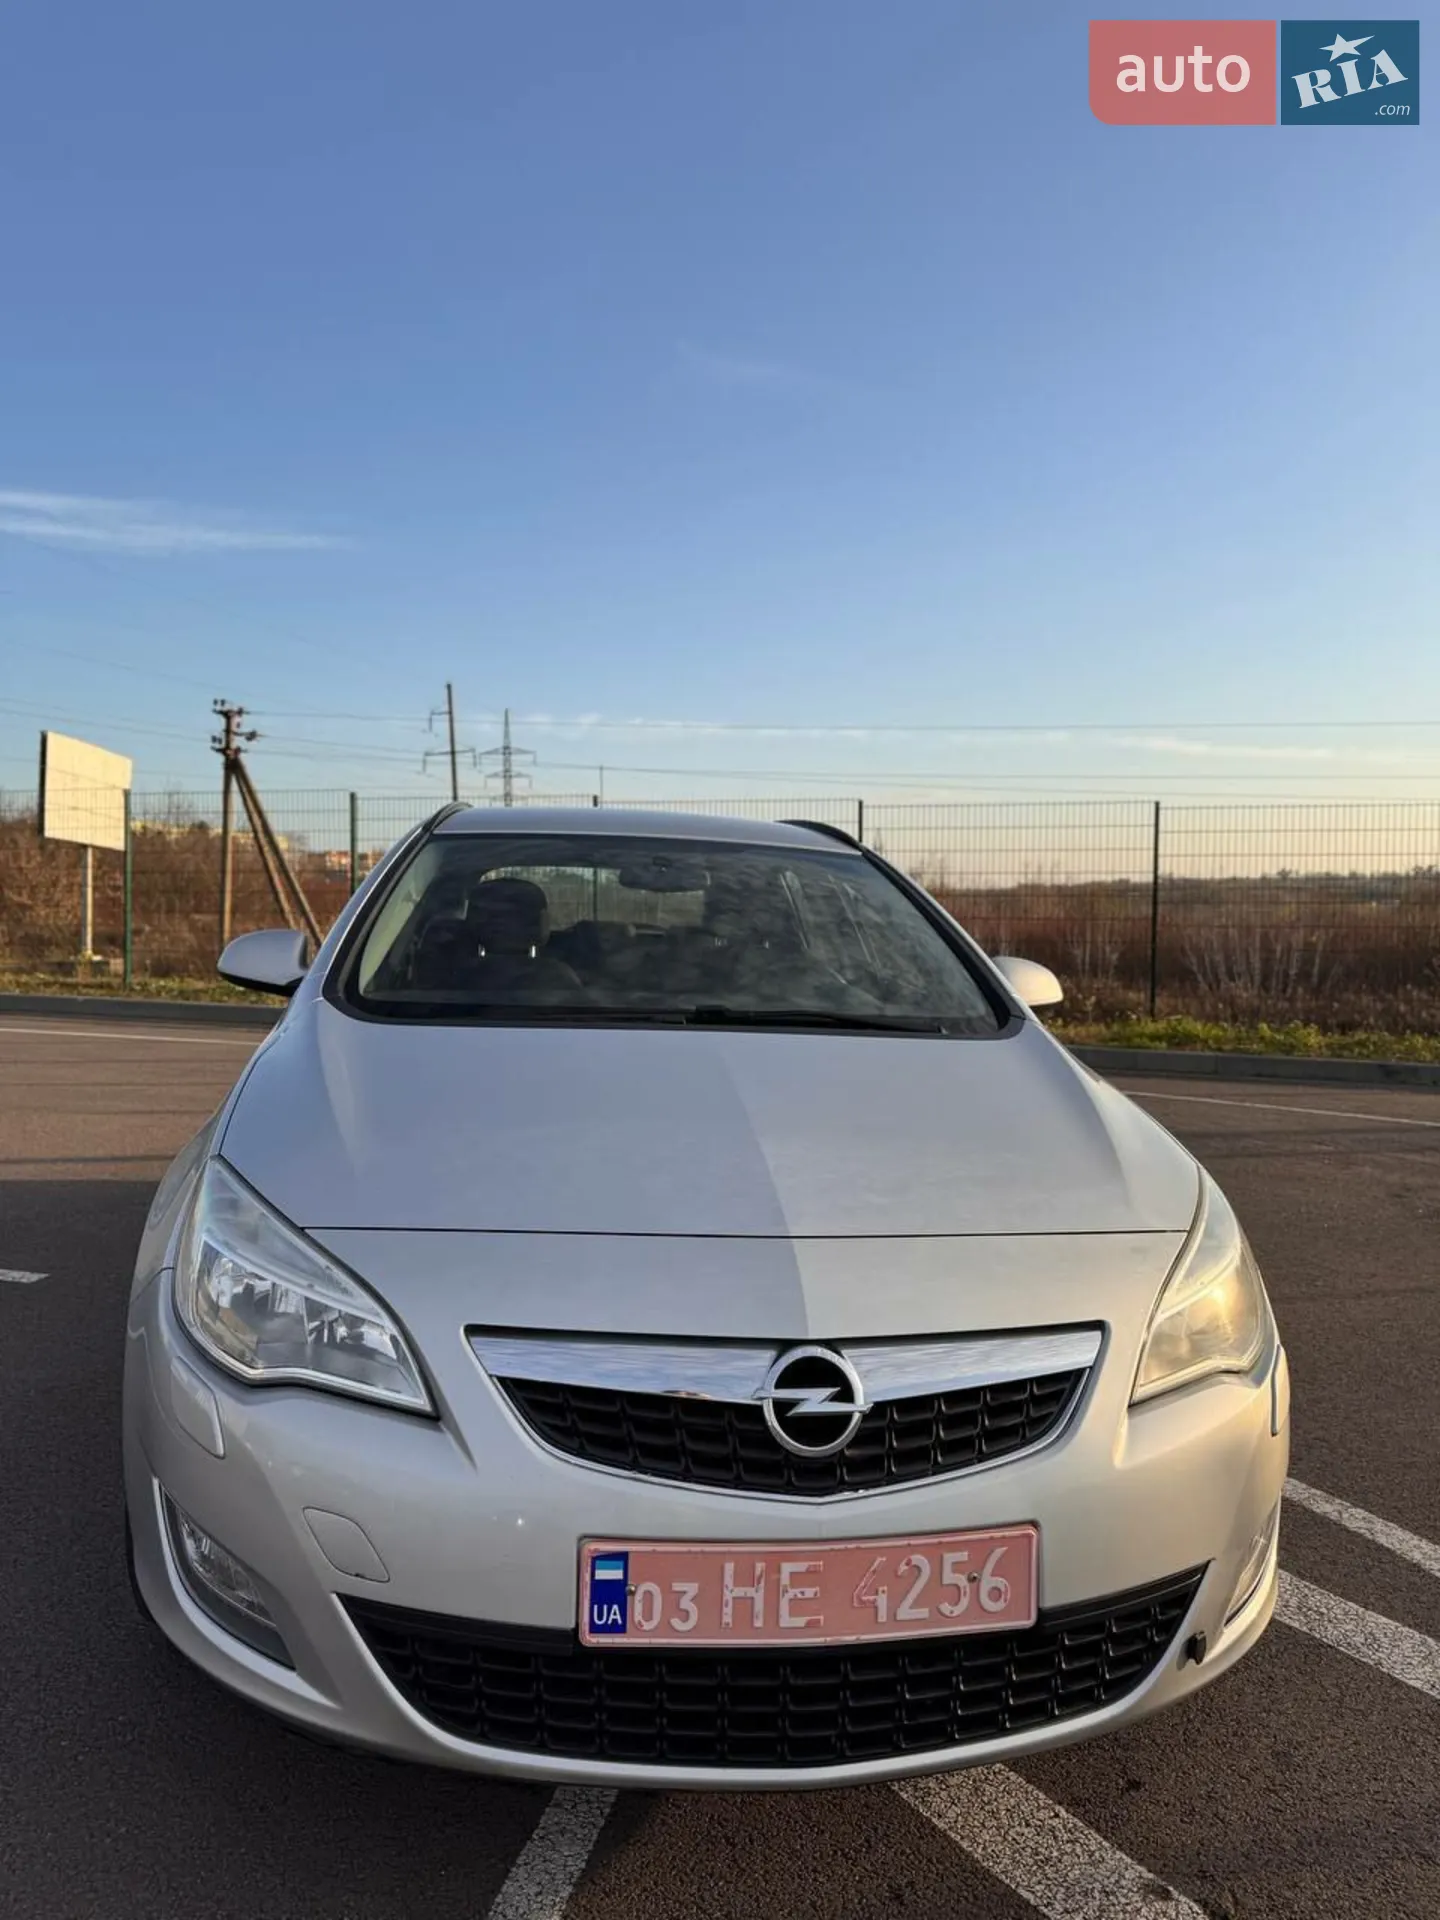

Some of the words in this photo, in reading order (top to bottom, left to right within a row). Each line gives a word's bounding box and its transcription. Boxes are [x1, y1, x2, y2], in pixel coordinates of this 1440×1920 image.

[593, 1604, 623, 1626] UA
[633, 1582, 699, 1631] 03
[721, 1561, 823, 1628] HE
[853, 1547, 1011, 1623] 4256
